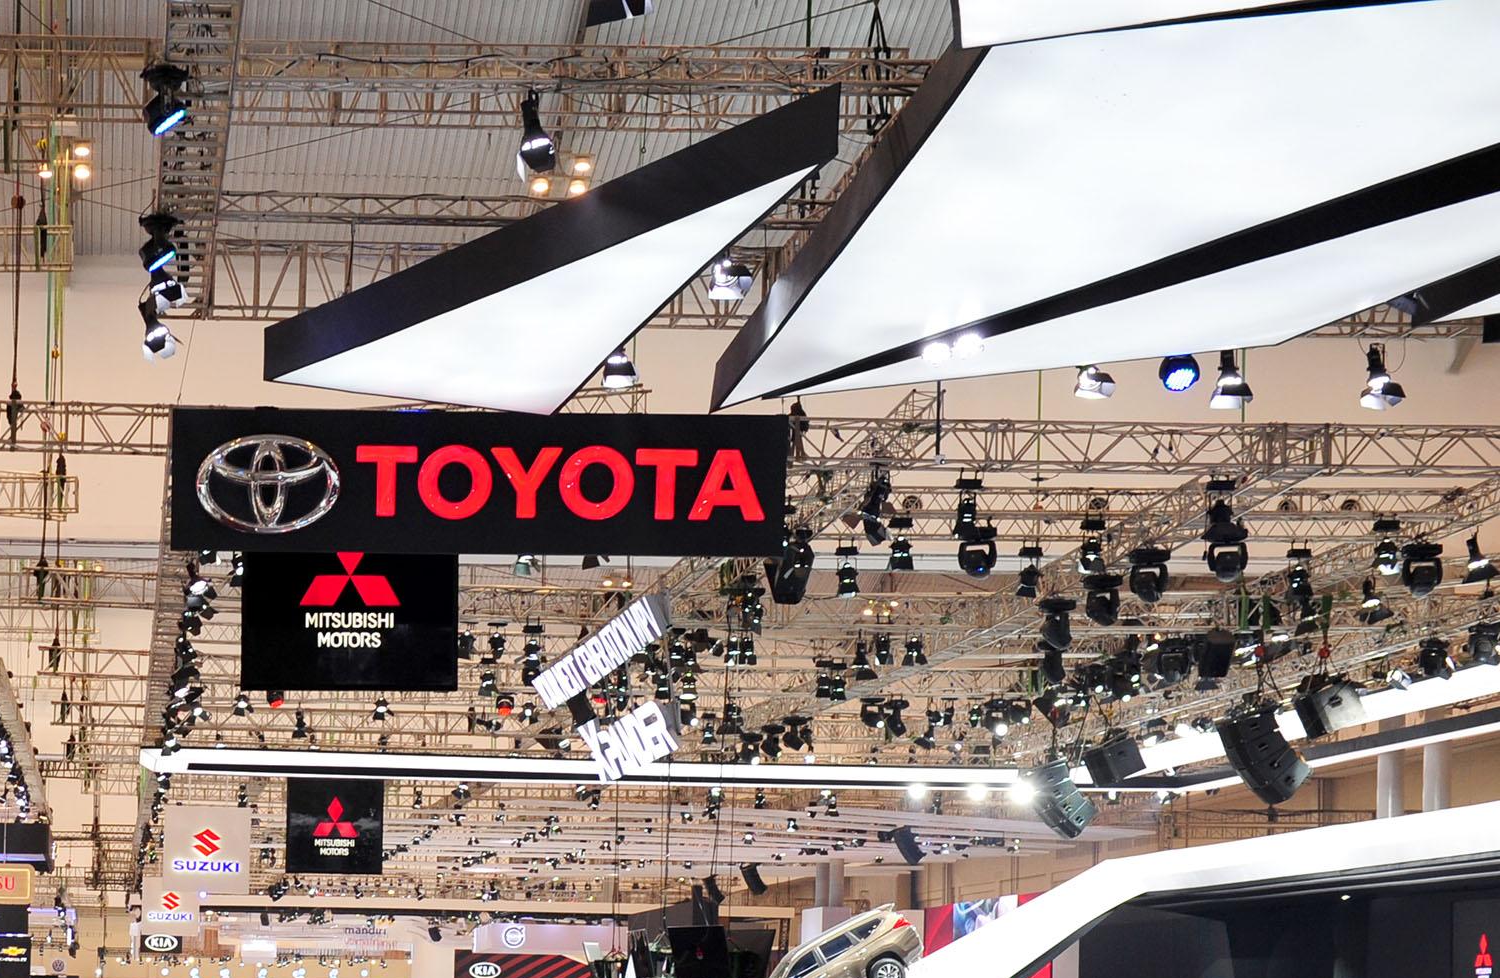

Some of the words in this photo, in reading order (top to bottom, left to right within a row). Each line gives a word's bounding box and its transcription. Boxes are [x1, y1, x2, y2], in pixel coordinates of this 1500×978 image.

[355, 444, 765, 522] TOYOTA
[304, 611, 395, 629] MITSUBISHI
[317, 631, 382, 648] MOTORS
[313, 838, 356, 848] MITSUBISHI
[319, 847, 350, 857] MOTORS
[173, 860, 240, 873] SUZUKI
[148, 912, 193, 921] SUZUKI
[344, 924, 387, 936] mandiri
[149, 937, 172, 949] KIA
[473, 965, 497, 976] KIA
